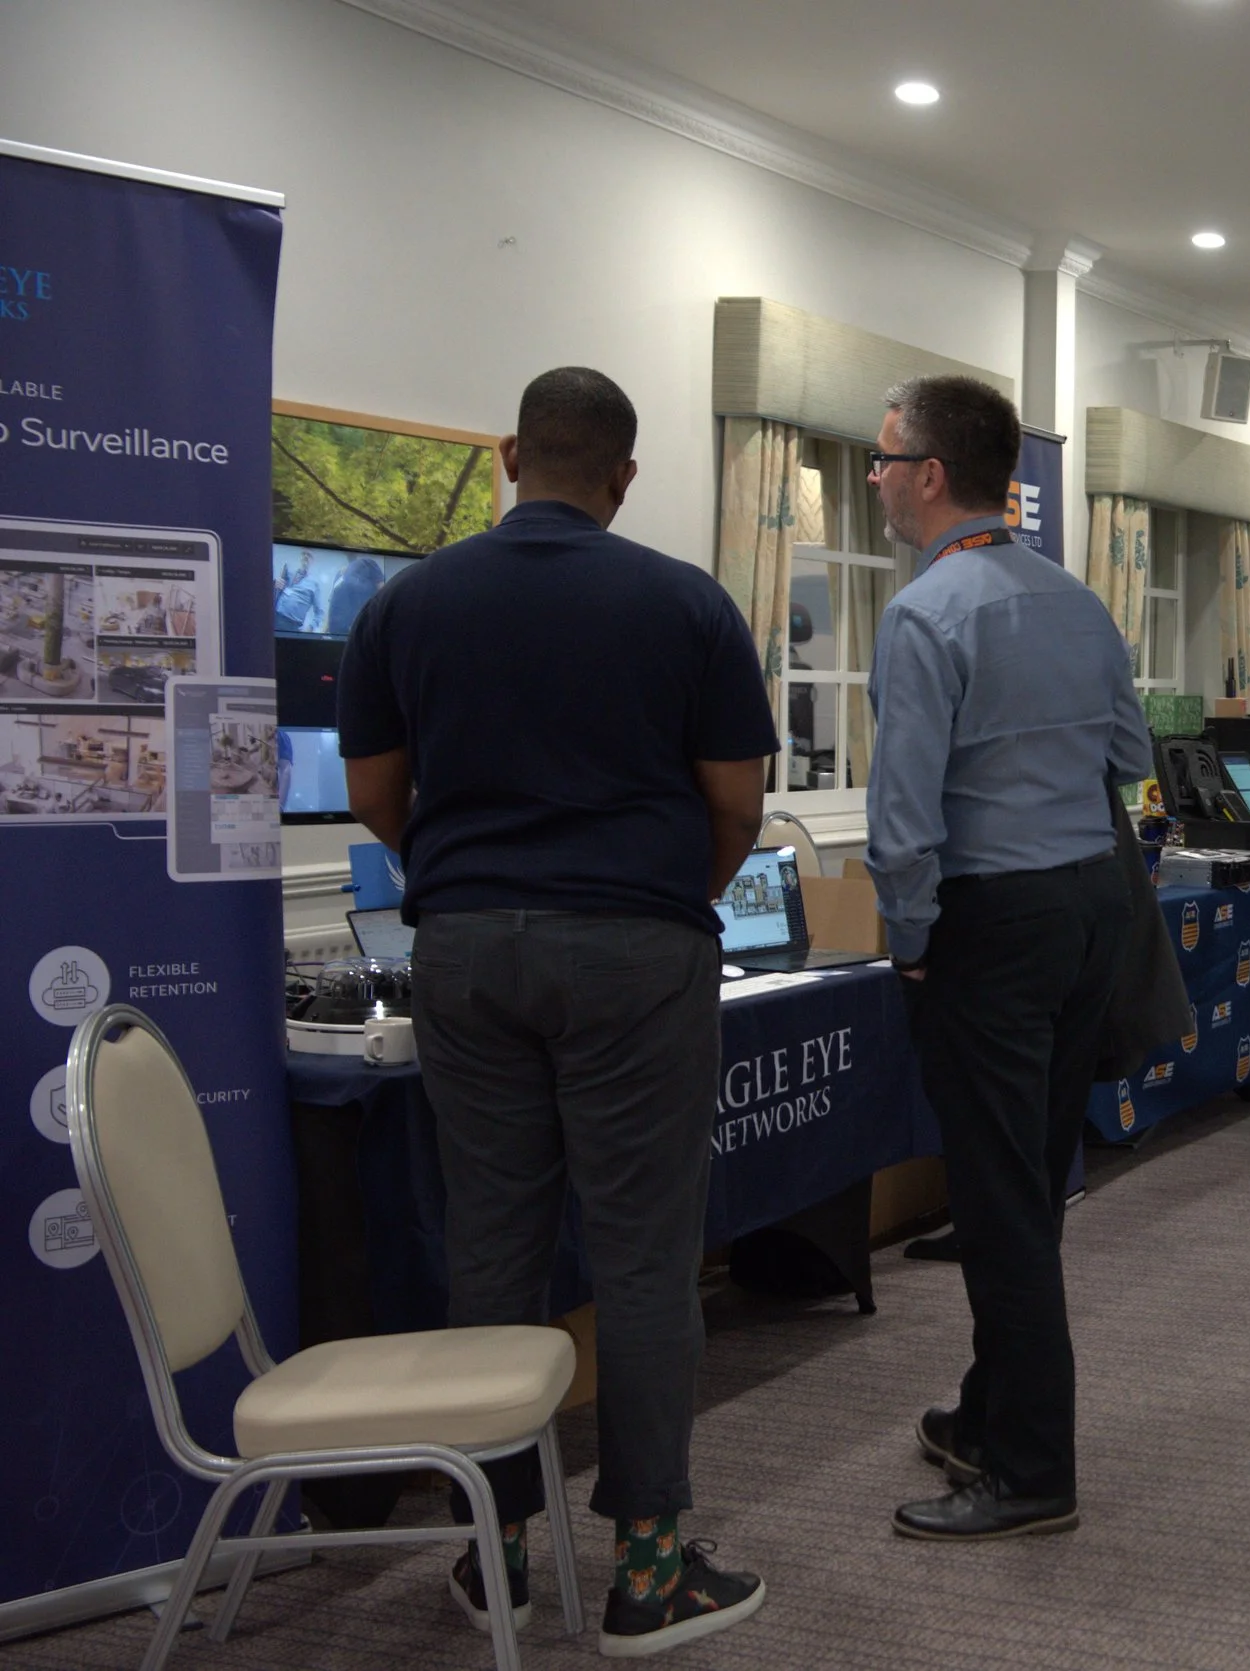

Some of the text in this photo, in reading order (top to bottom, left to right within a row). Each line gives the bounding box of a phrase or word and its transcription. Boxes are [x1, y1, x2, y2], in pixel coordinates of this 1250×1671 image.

[21, 417, 229, 465] Surveillance
[1213, 903, 1234, 922] ASE
[129, 962, 200, 978] FLEXIBLE
[129, 981, 218, 999] RETENTION
[1211, 1000, 1232, 1022] ASE
[801, 1027, 852, 1086] EYE
[1143, 1060, 1175, 1083] ASE
[710, 1085, 832, 1160] NETWORKS
